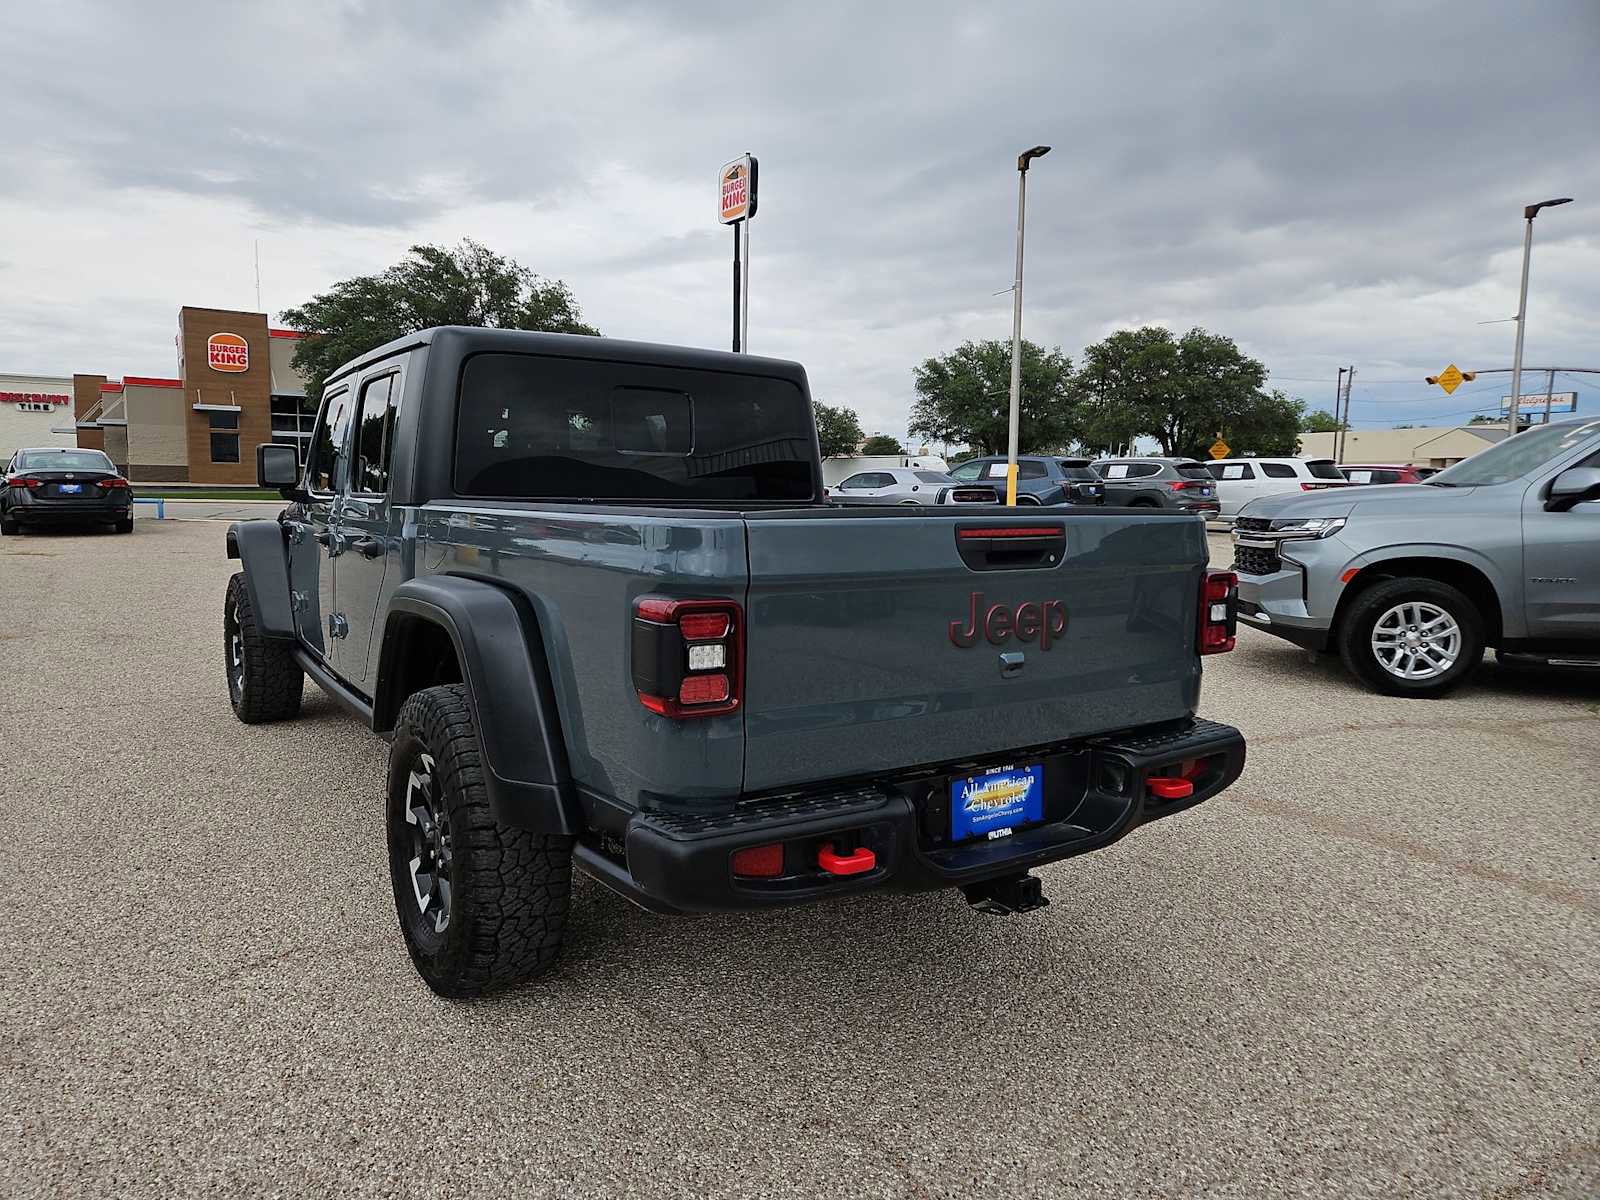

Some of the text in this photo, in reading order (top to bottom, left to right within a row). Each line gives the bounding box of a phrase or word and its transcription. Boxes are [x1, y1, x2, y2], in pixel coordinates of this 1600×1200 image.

[722, 189, 746, 211] KING
[210, 344, 247, 354] BURGER
[210, 352, 247, 365] KING
[949, 591, 1068, 651] Jeep
[985, 766, 1001, 775] SINCE
[961, 775, 1034, 800] All American
[971, 791, 1026, 812] Chevrolet
